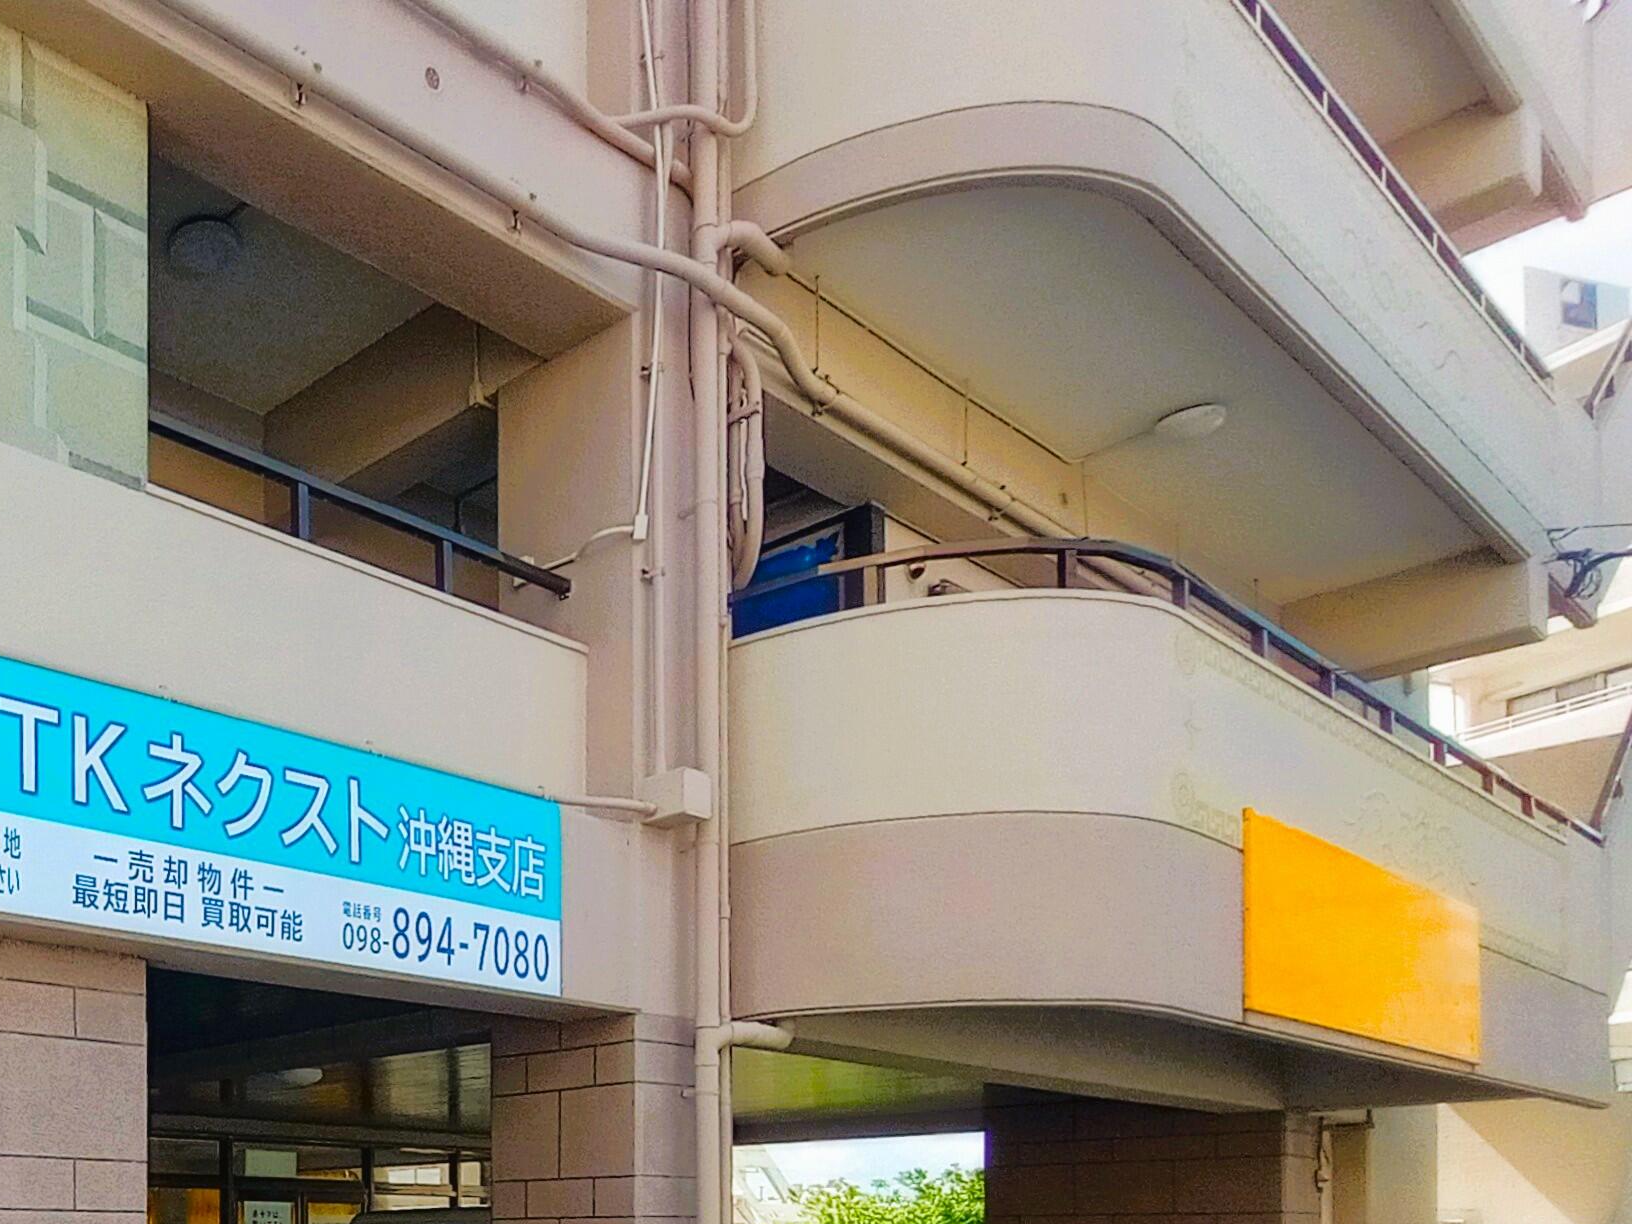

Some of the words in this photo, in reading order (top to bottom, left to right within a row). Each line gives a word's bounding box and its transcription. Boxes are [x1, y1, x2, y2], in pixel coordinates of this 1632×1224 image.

[398, 804, 547, 901] 沖縄支店
[72, 875, 186, 924] 最短即日
[200, 897, 304, 943] 買取可能
[342, 907, 550, 983] 098-894-7080
